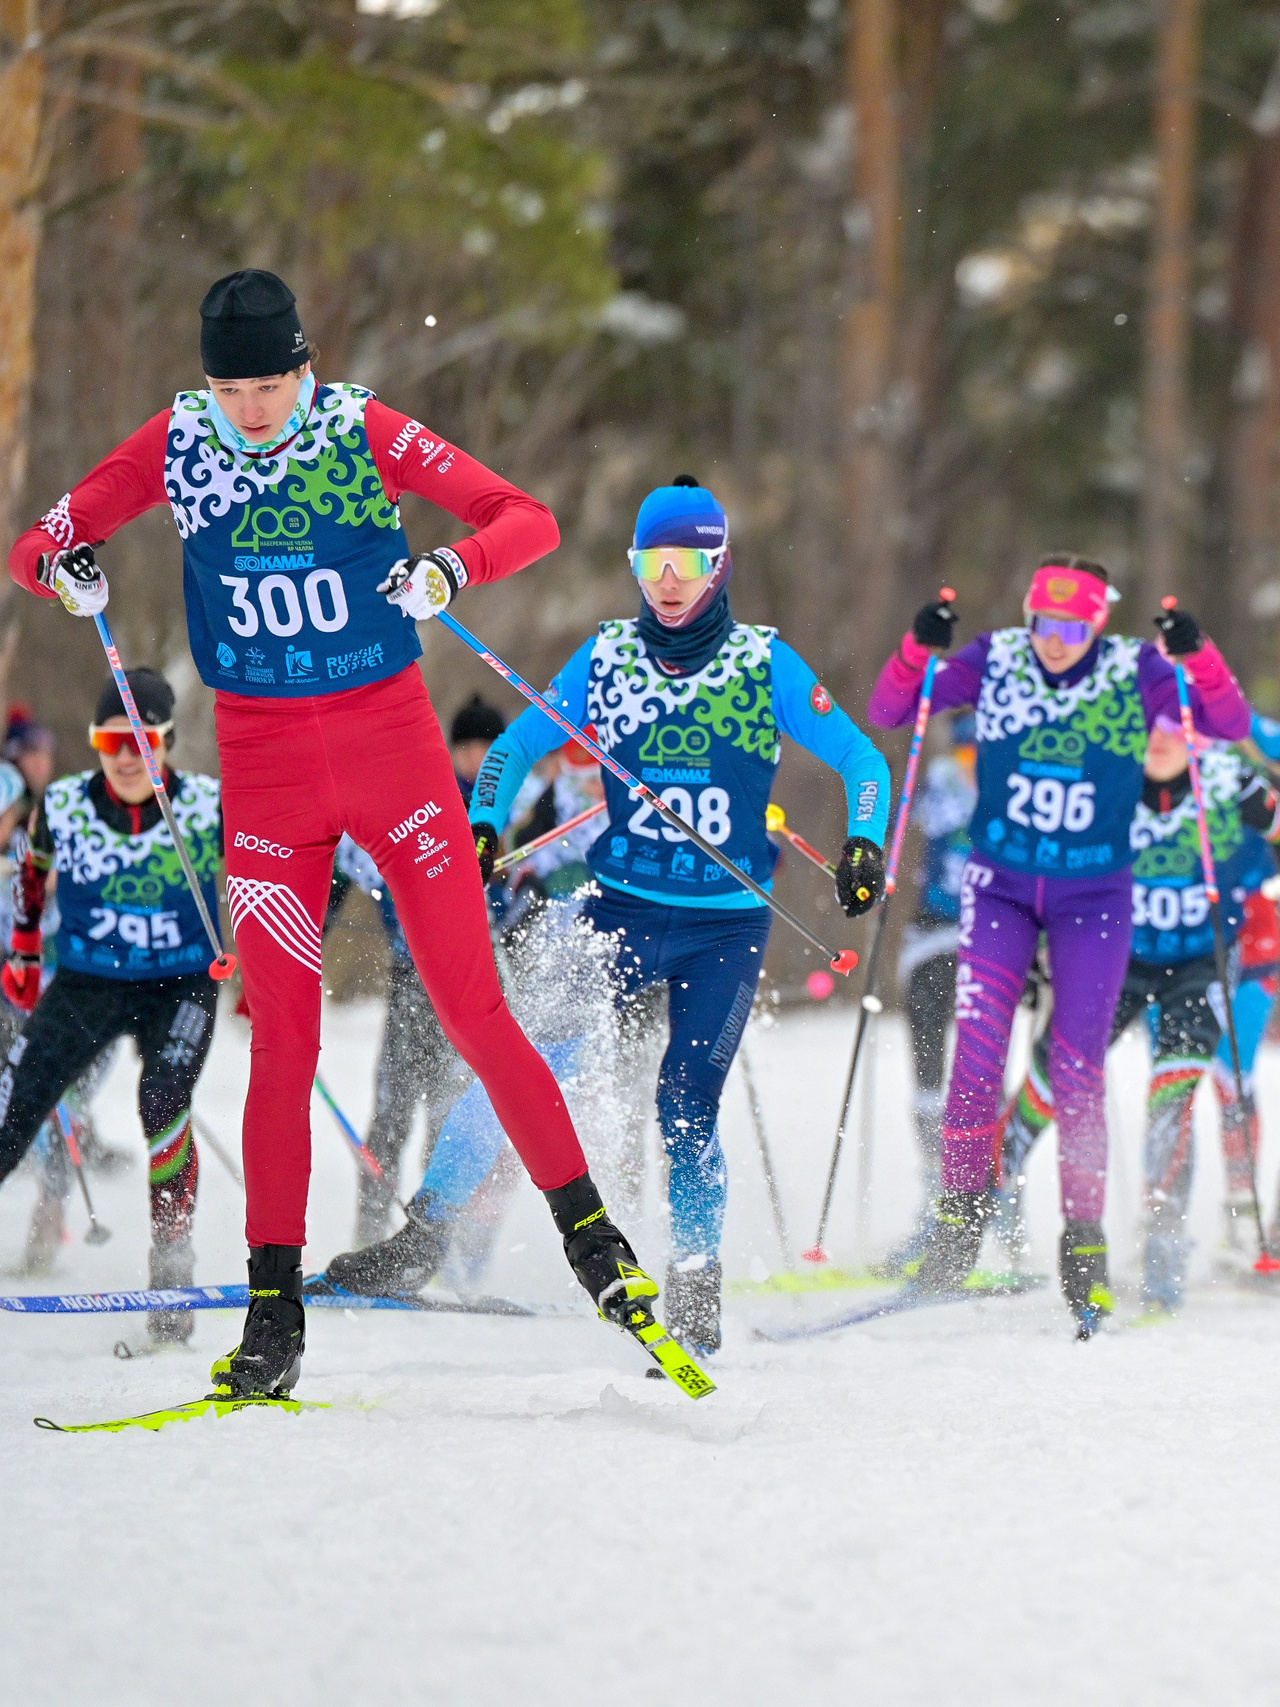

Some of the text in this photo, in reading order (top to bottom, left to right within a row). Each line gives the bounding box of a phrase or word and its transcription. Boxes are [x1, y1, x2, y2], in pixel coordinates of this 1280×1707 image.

[219, 569, 349, 637] 300
[627, 786, 731, 846] 298
[1007, 772, 1096, 833] 296
[387, 800, 443, 845] LUKOIL
[233, 831, 293, 859] BOSCO
[414, 839, 449, 865] PHOSAGRO
[426, 854, 452, 879] EN+
[88, 907, 183, 949] 295
[574, 1206, 607, 1231] FISCH
[248, 1288, 281, 1298] CHER
